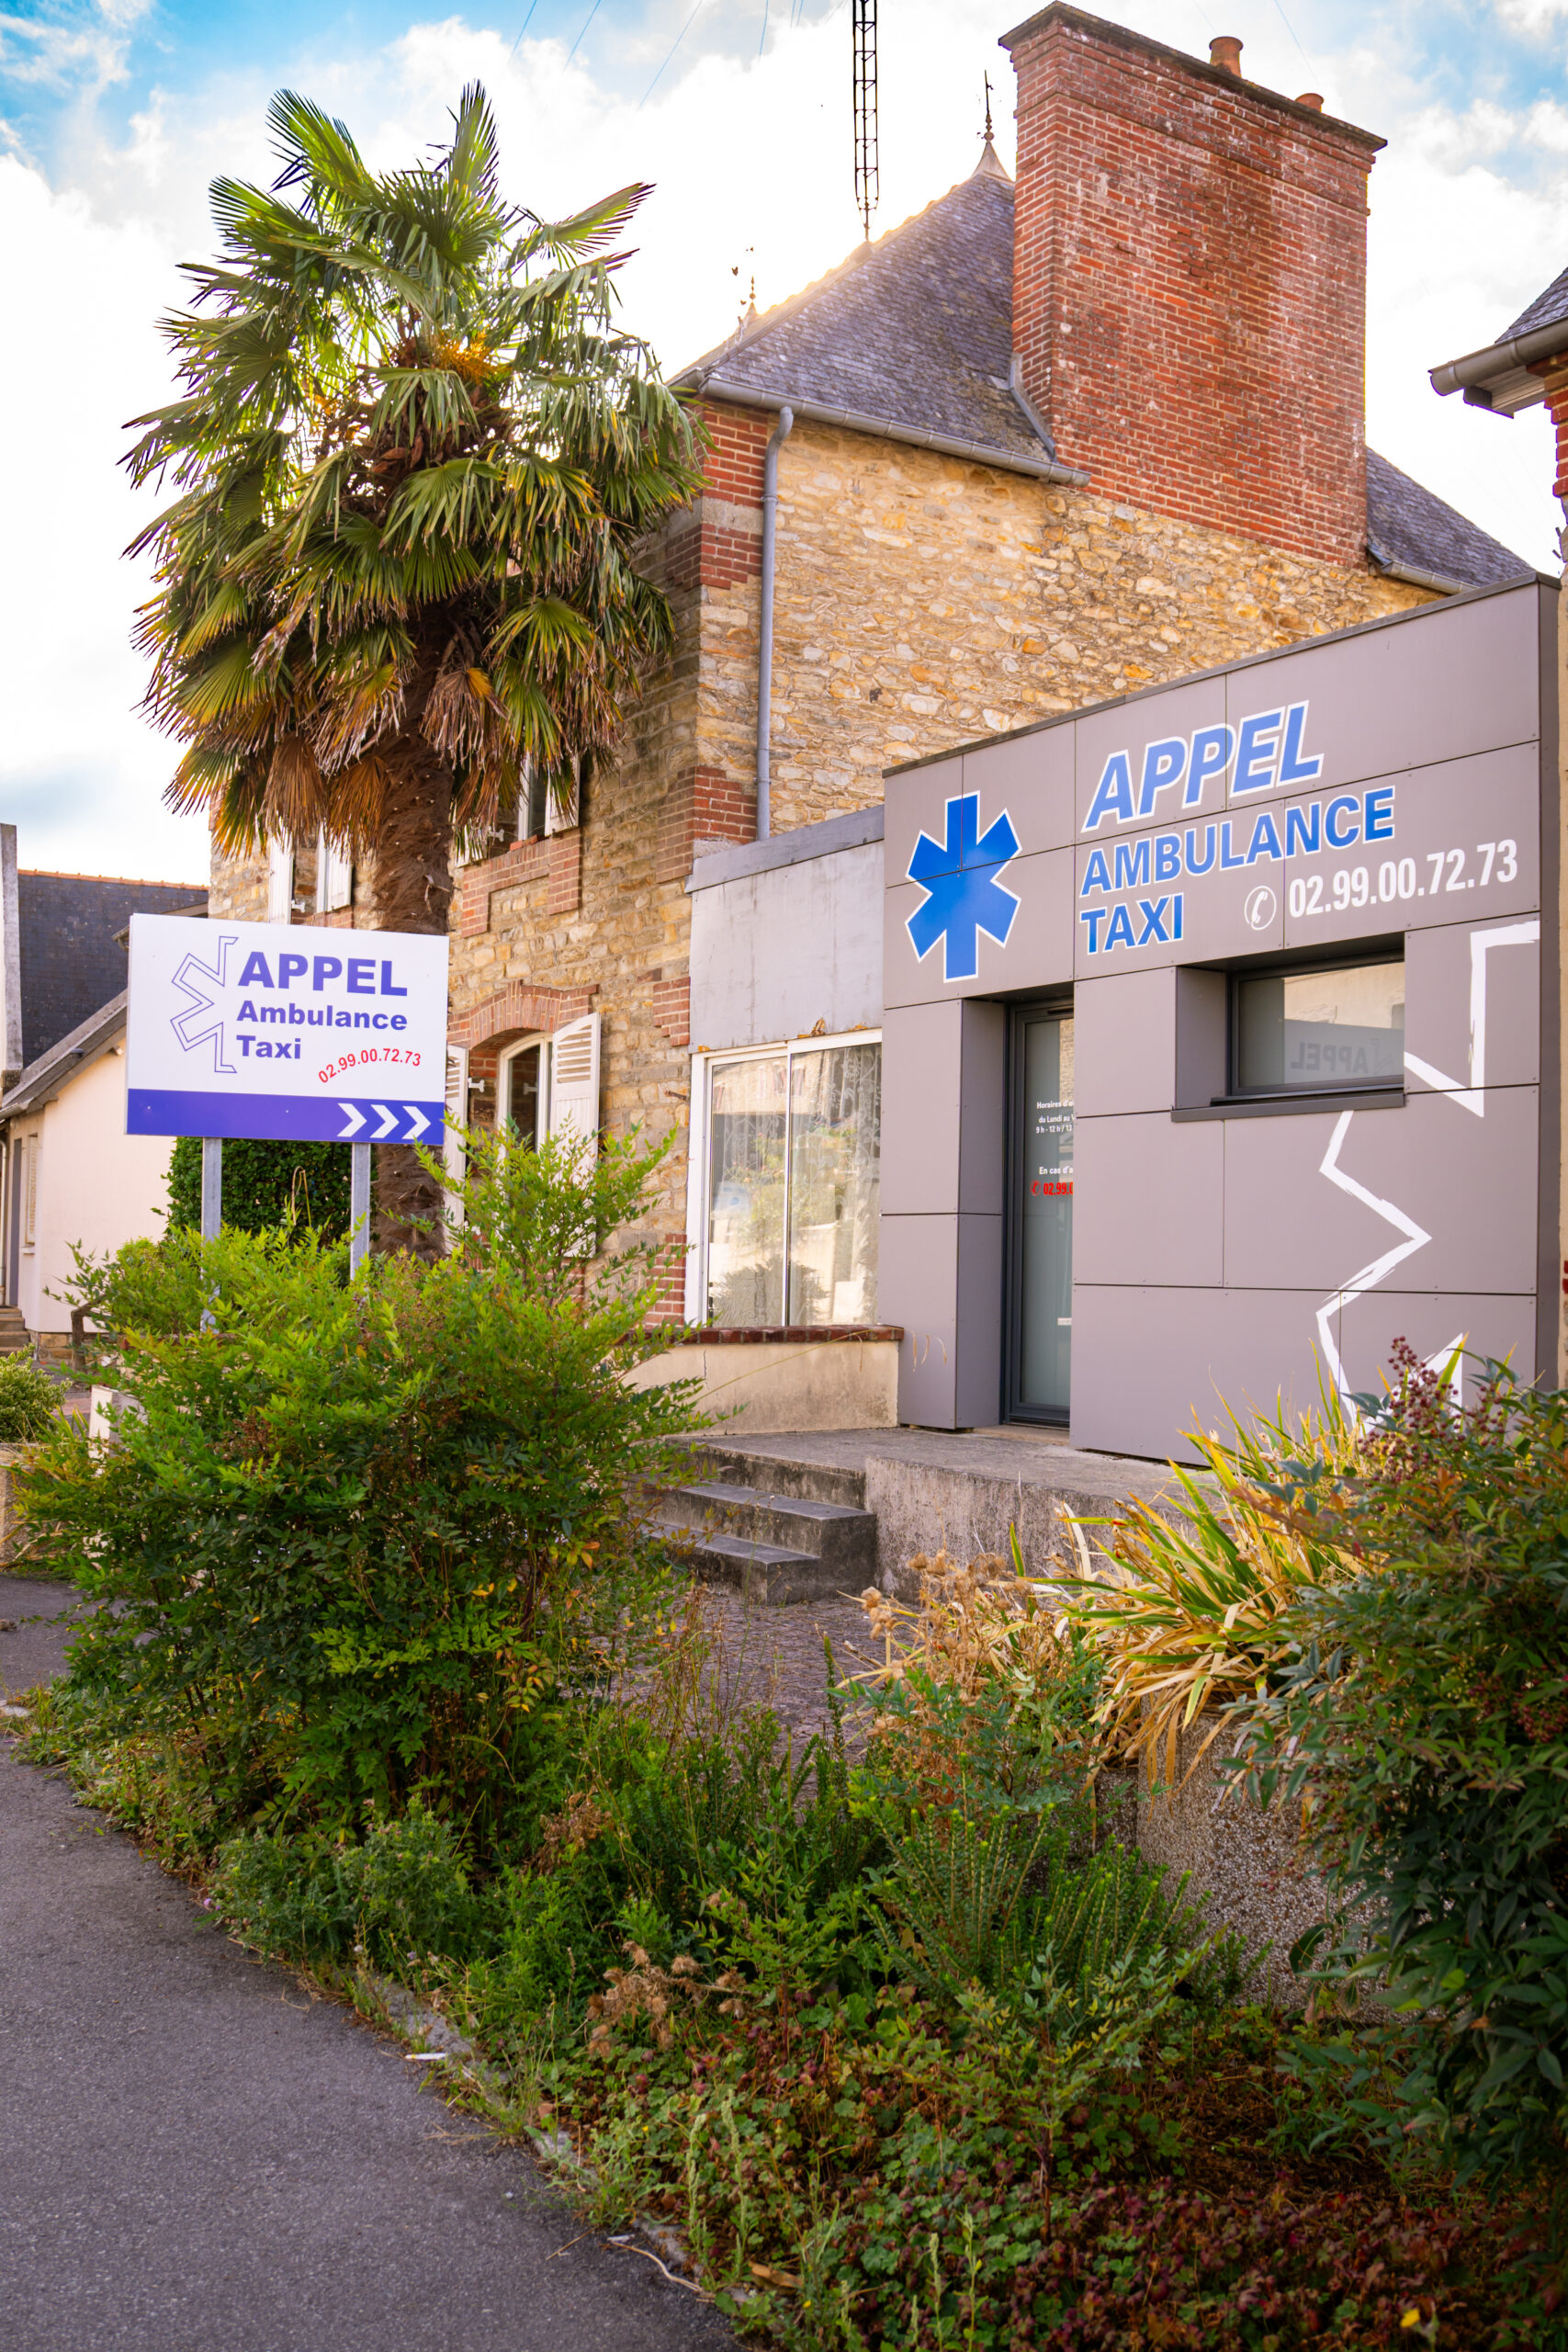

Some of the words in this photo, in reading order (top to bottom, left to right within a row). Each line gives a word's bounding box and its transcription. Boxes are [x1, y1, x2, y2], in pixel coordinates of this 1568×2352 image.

[1080, 699, 1325, 833] APPEL
[1079, 785, 1395, 898] AMBULANCE
[1289, 839, 1517, 918] 02.99.00.72.73
[1079, 892, 1184, 955] TAXI
[237, 951, 408, 997] APPEL
[236, 1000, 408, 1031] Ambulance
[236, 1035, 301, 1059] Taxi
[318, 1047, 422, 1083] 02.99.00.72.73
[1036, 1101, 1061, 1110] Horaires
[1063, 1100, 1074, 1108] d'o
[1038, 1115, 1046, 1124] du
[1047, 1114, 1062, 1123] Lundi
[1039, 1166, 1048, 1175] En
